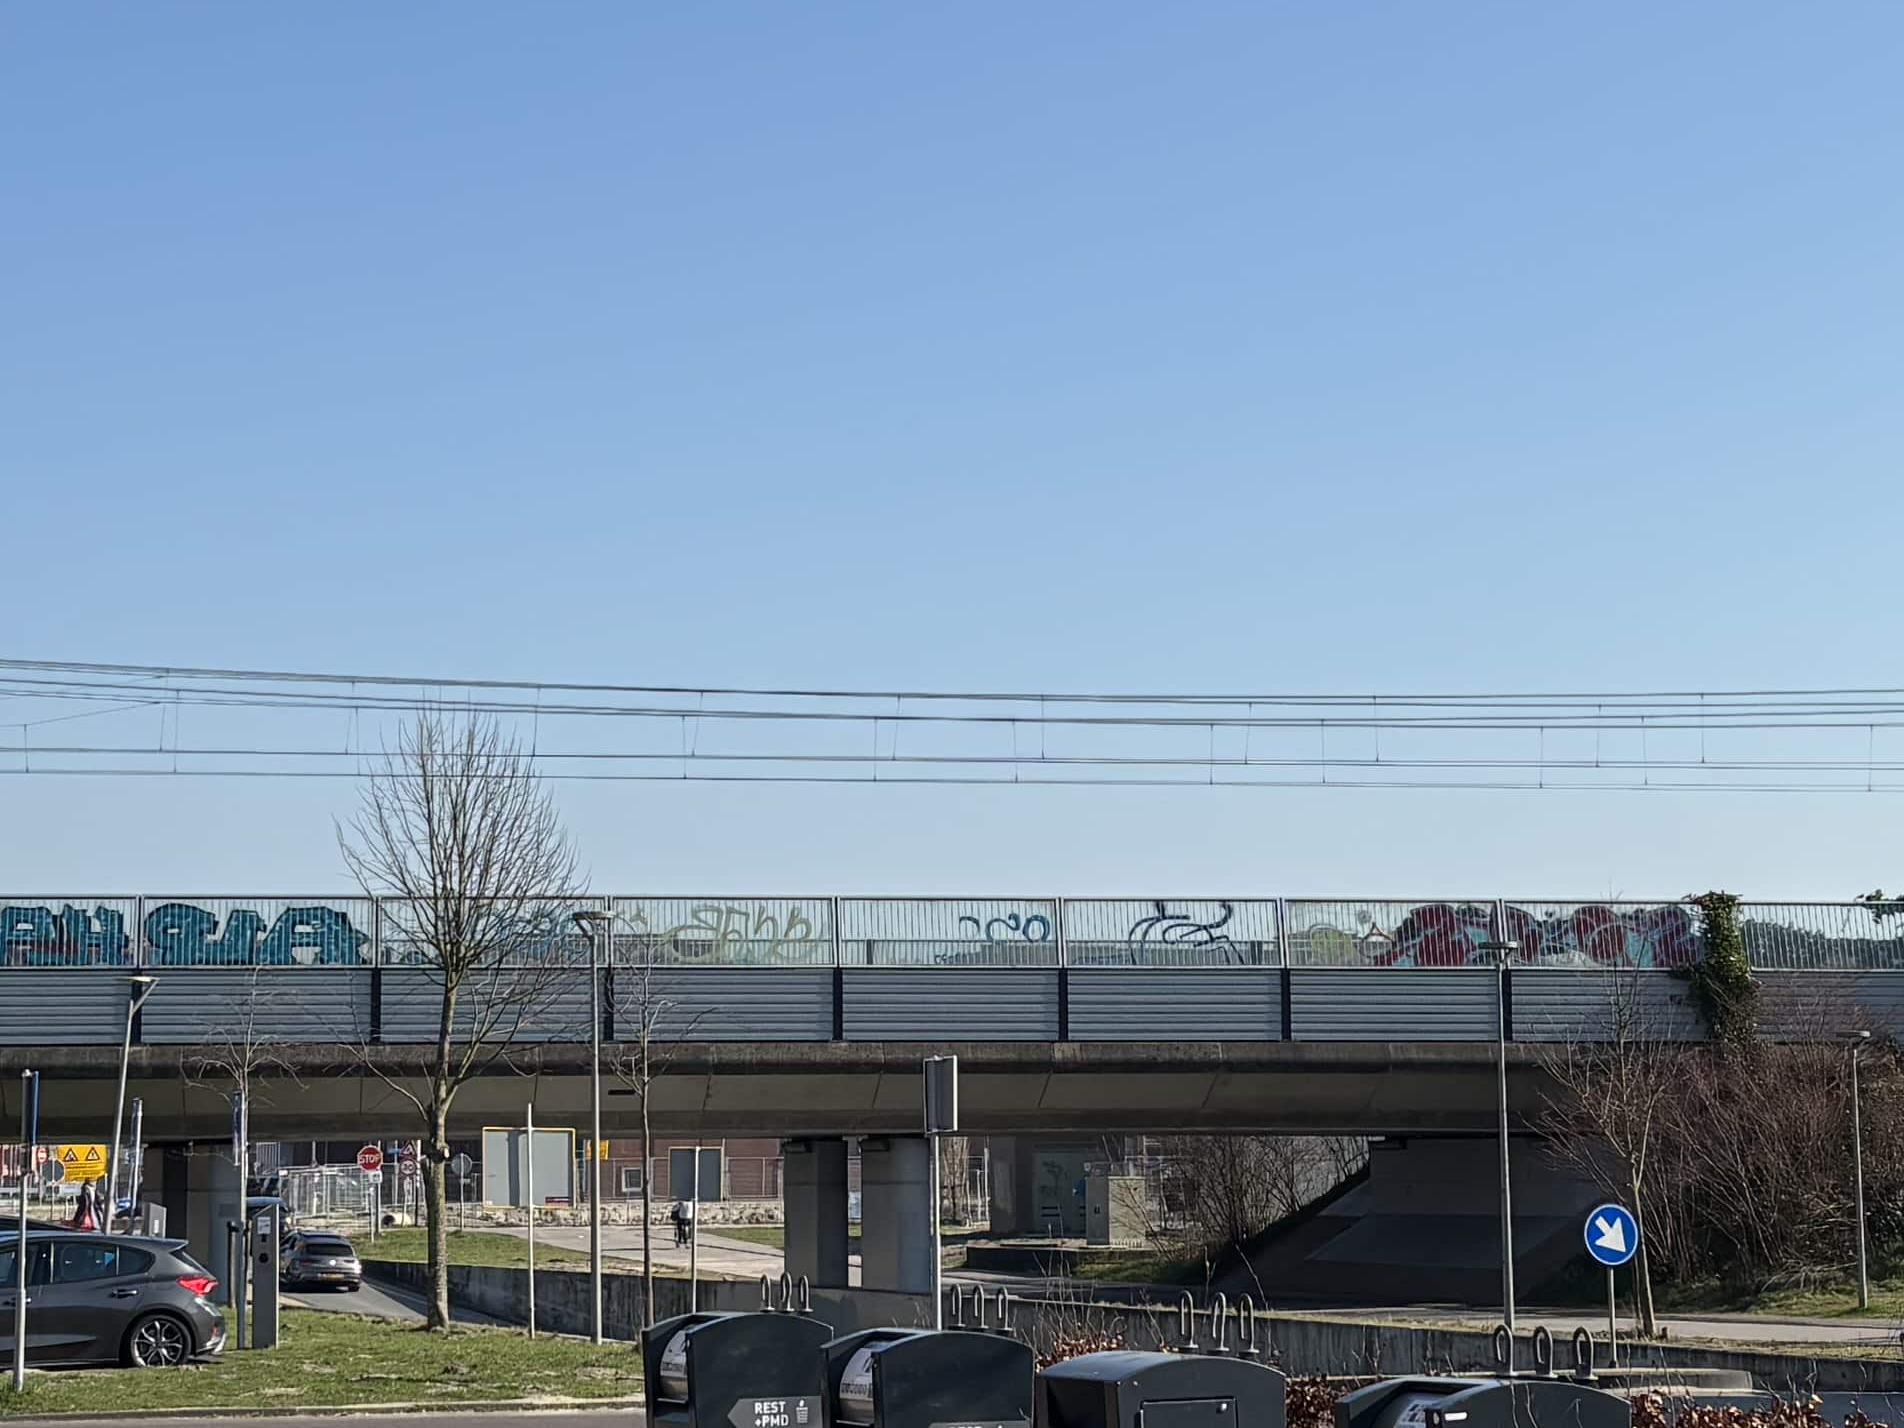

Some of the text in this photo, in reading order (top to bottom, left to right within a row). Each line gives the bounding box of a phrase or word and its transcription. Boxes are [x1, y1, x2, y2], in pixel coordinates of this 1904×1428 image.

[359, 1155, 380, 1164] STOP
[755, 1401, 786, 1414] REST
[755, 1414, 789, 1427] +PMD
